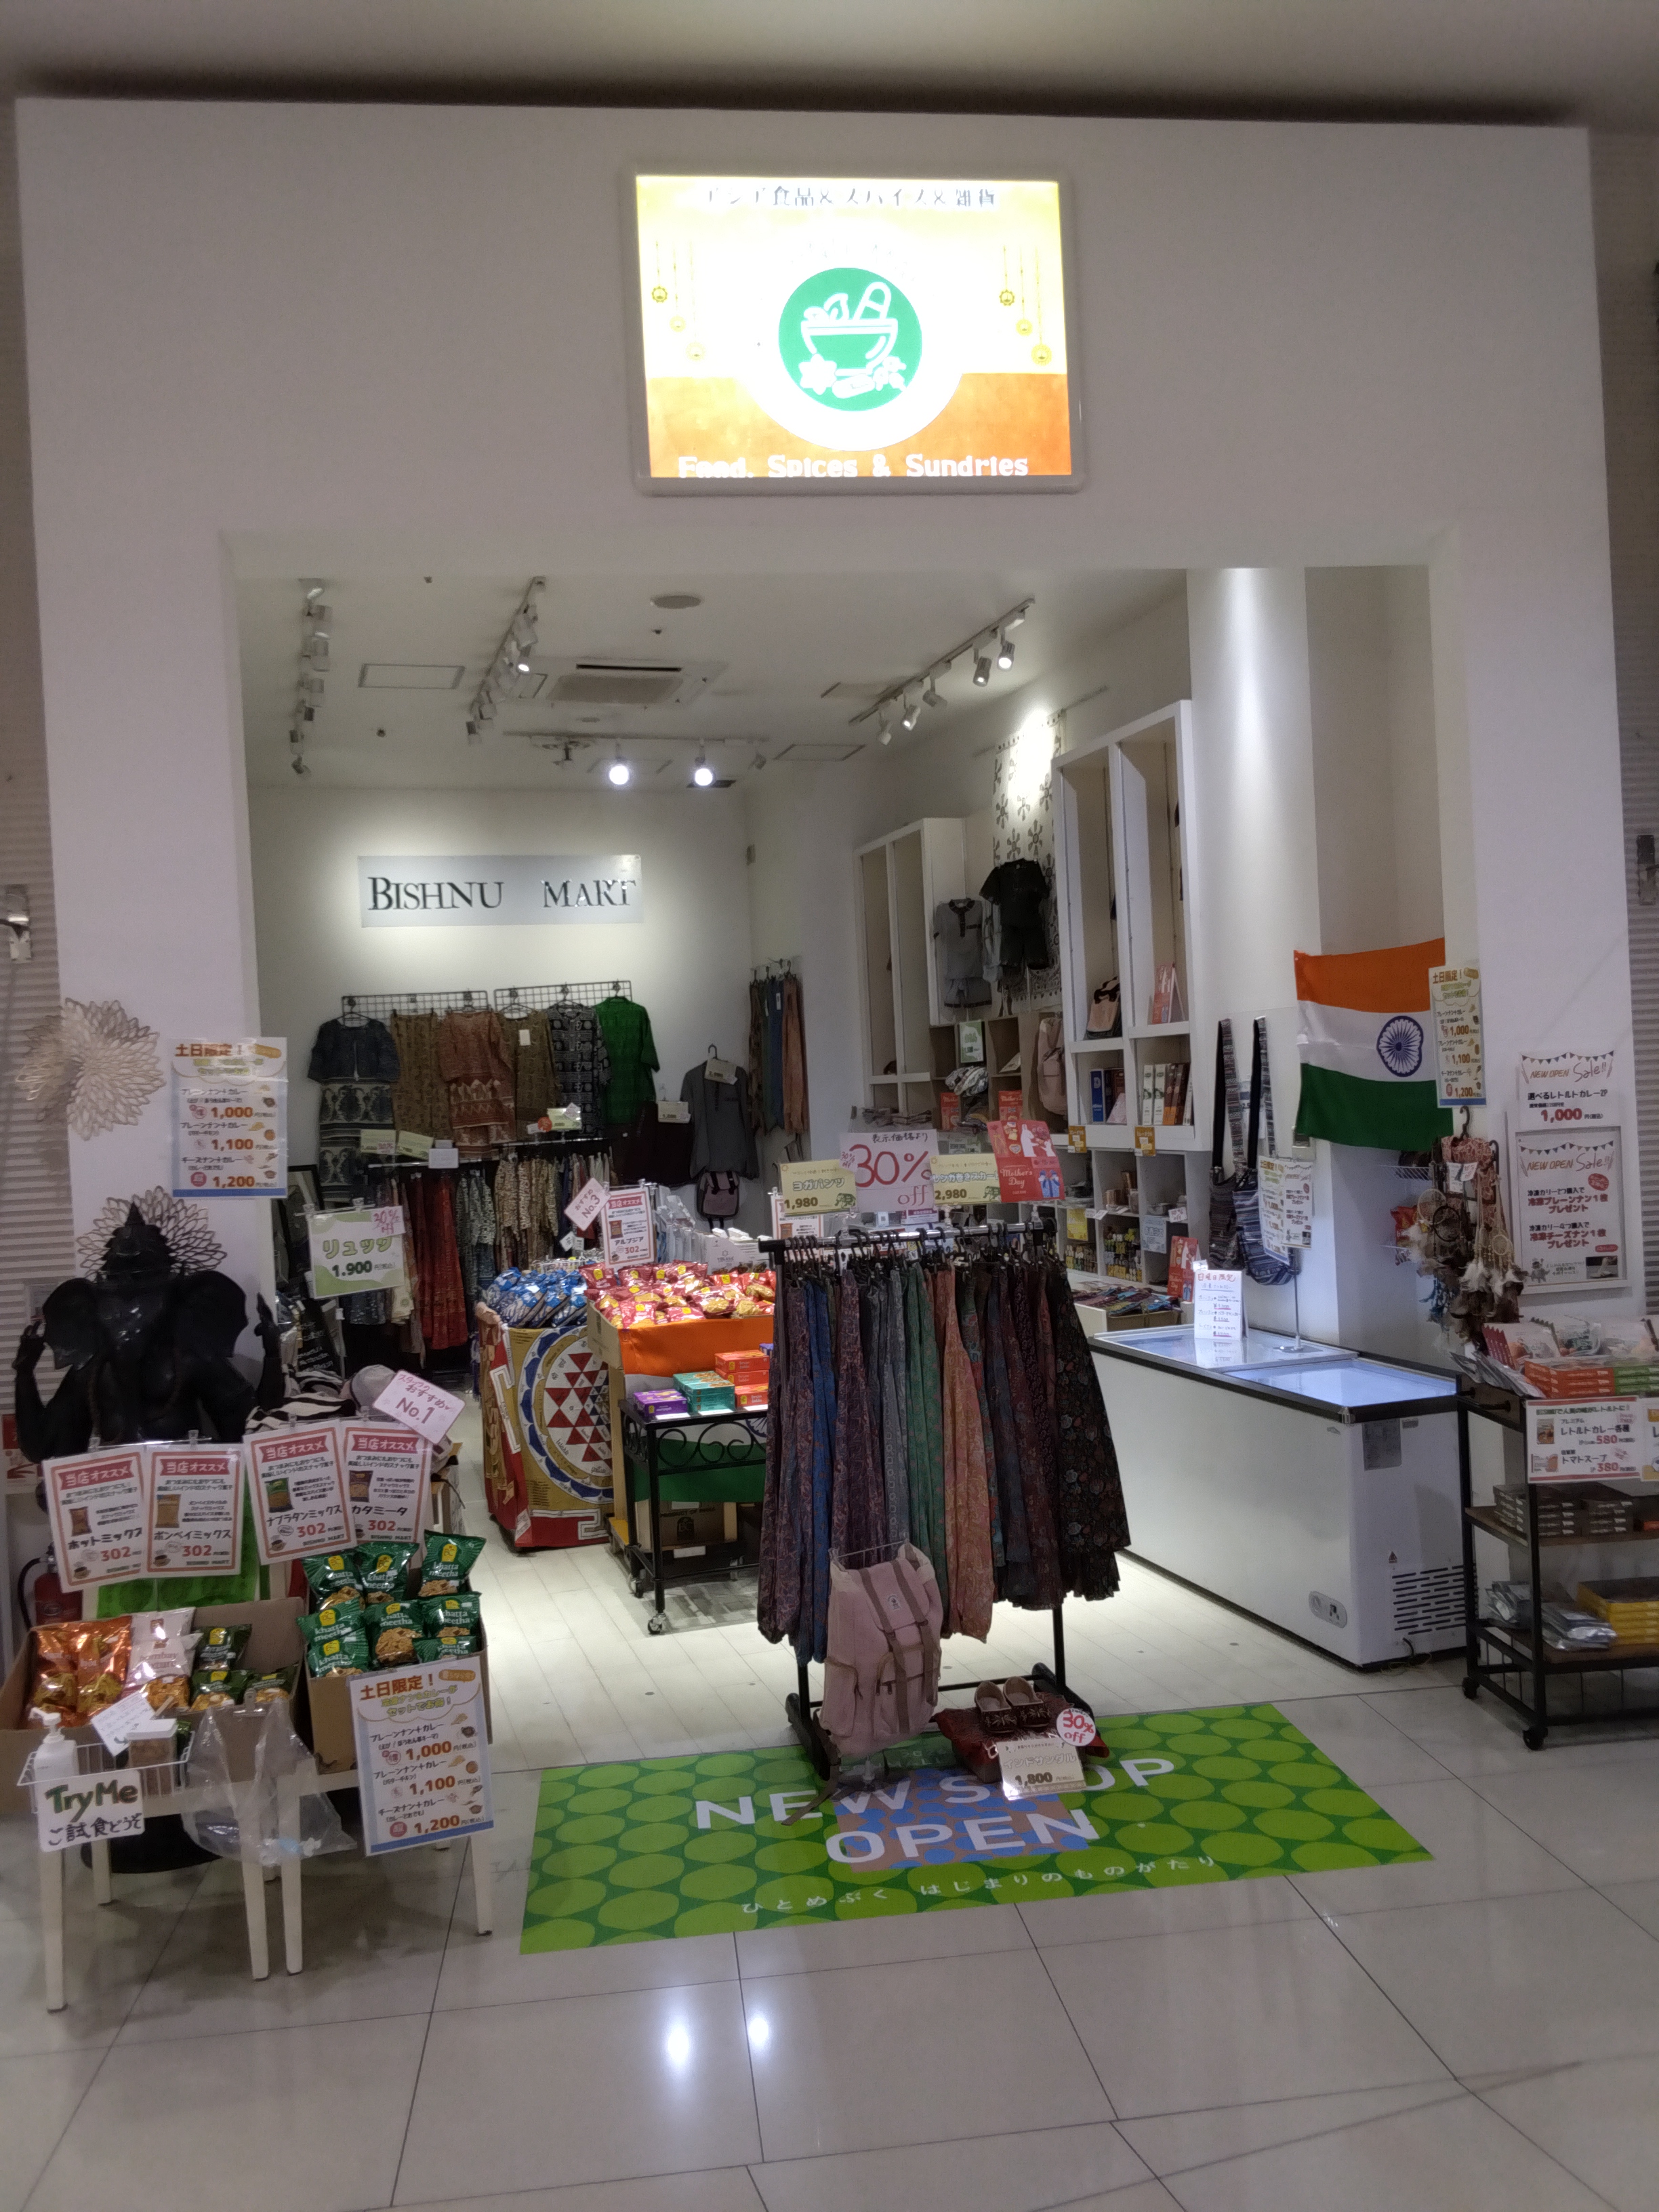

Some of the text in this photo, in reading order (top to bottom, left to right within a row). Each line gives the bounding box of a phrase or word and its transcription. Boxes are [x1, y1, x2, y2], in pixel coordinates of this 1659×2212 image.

[872, 454, 891, 477] &
[905, 453, 1029, 476] Sundries
[211, 1107, 253, 1120] 1,000
[1540, 1107, 1582, 1124] 1,000
[211, 1139, 253, 1152] 1,100
[849, 1143, 933, 1188] 30%
[1000, 1167, 1033, 1178] Mother's
[212, 1176, 255, 1189] 1,200
[1008, 1176, 1025, 1189] Day
[897, 1184, 929, 1207] off
[934, 1182, 968, 1201] 2,980
[784, 1197, 819, 1210] 1,980
[625, 1246, 640, 1254] 302
[395, 1397, 436, 1424] No.1
[357, 1437, 415, 1451] 当店オススメ
[1596, 1435, 1618, 1445] 580
[266, 1440, 325, 1460] 当店オススメ
[166, 1461, 226, 1474] 当店オススメ
[1597, 1462, 1619, 1473] 380
[296, 1522, 327, 1538] 302
[368, 1519, 397, 1532] 302
[100, 1546, 131, 1562] 302
[182, 1544, 213, 1557] 302
[1062, 1711, 1094, 1734] 30%
[405, 1740, 453, 1761] 1,000
[409, 1775, 456, 1796] 1,100
[939, 1757, 1174, 1804] SOP
[1015, 1771, 1053, 1786] 1,800
[44, 1779, 138, 1823] Try Me
[413, 1814, 460, 1835] 1,200
[825, 1808, 1100, 1864] OPEN
